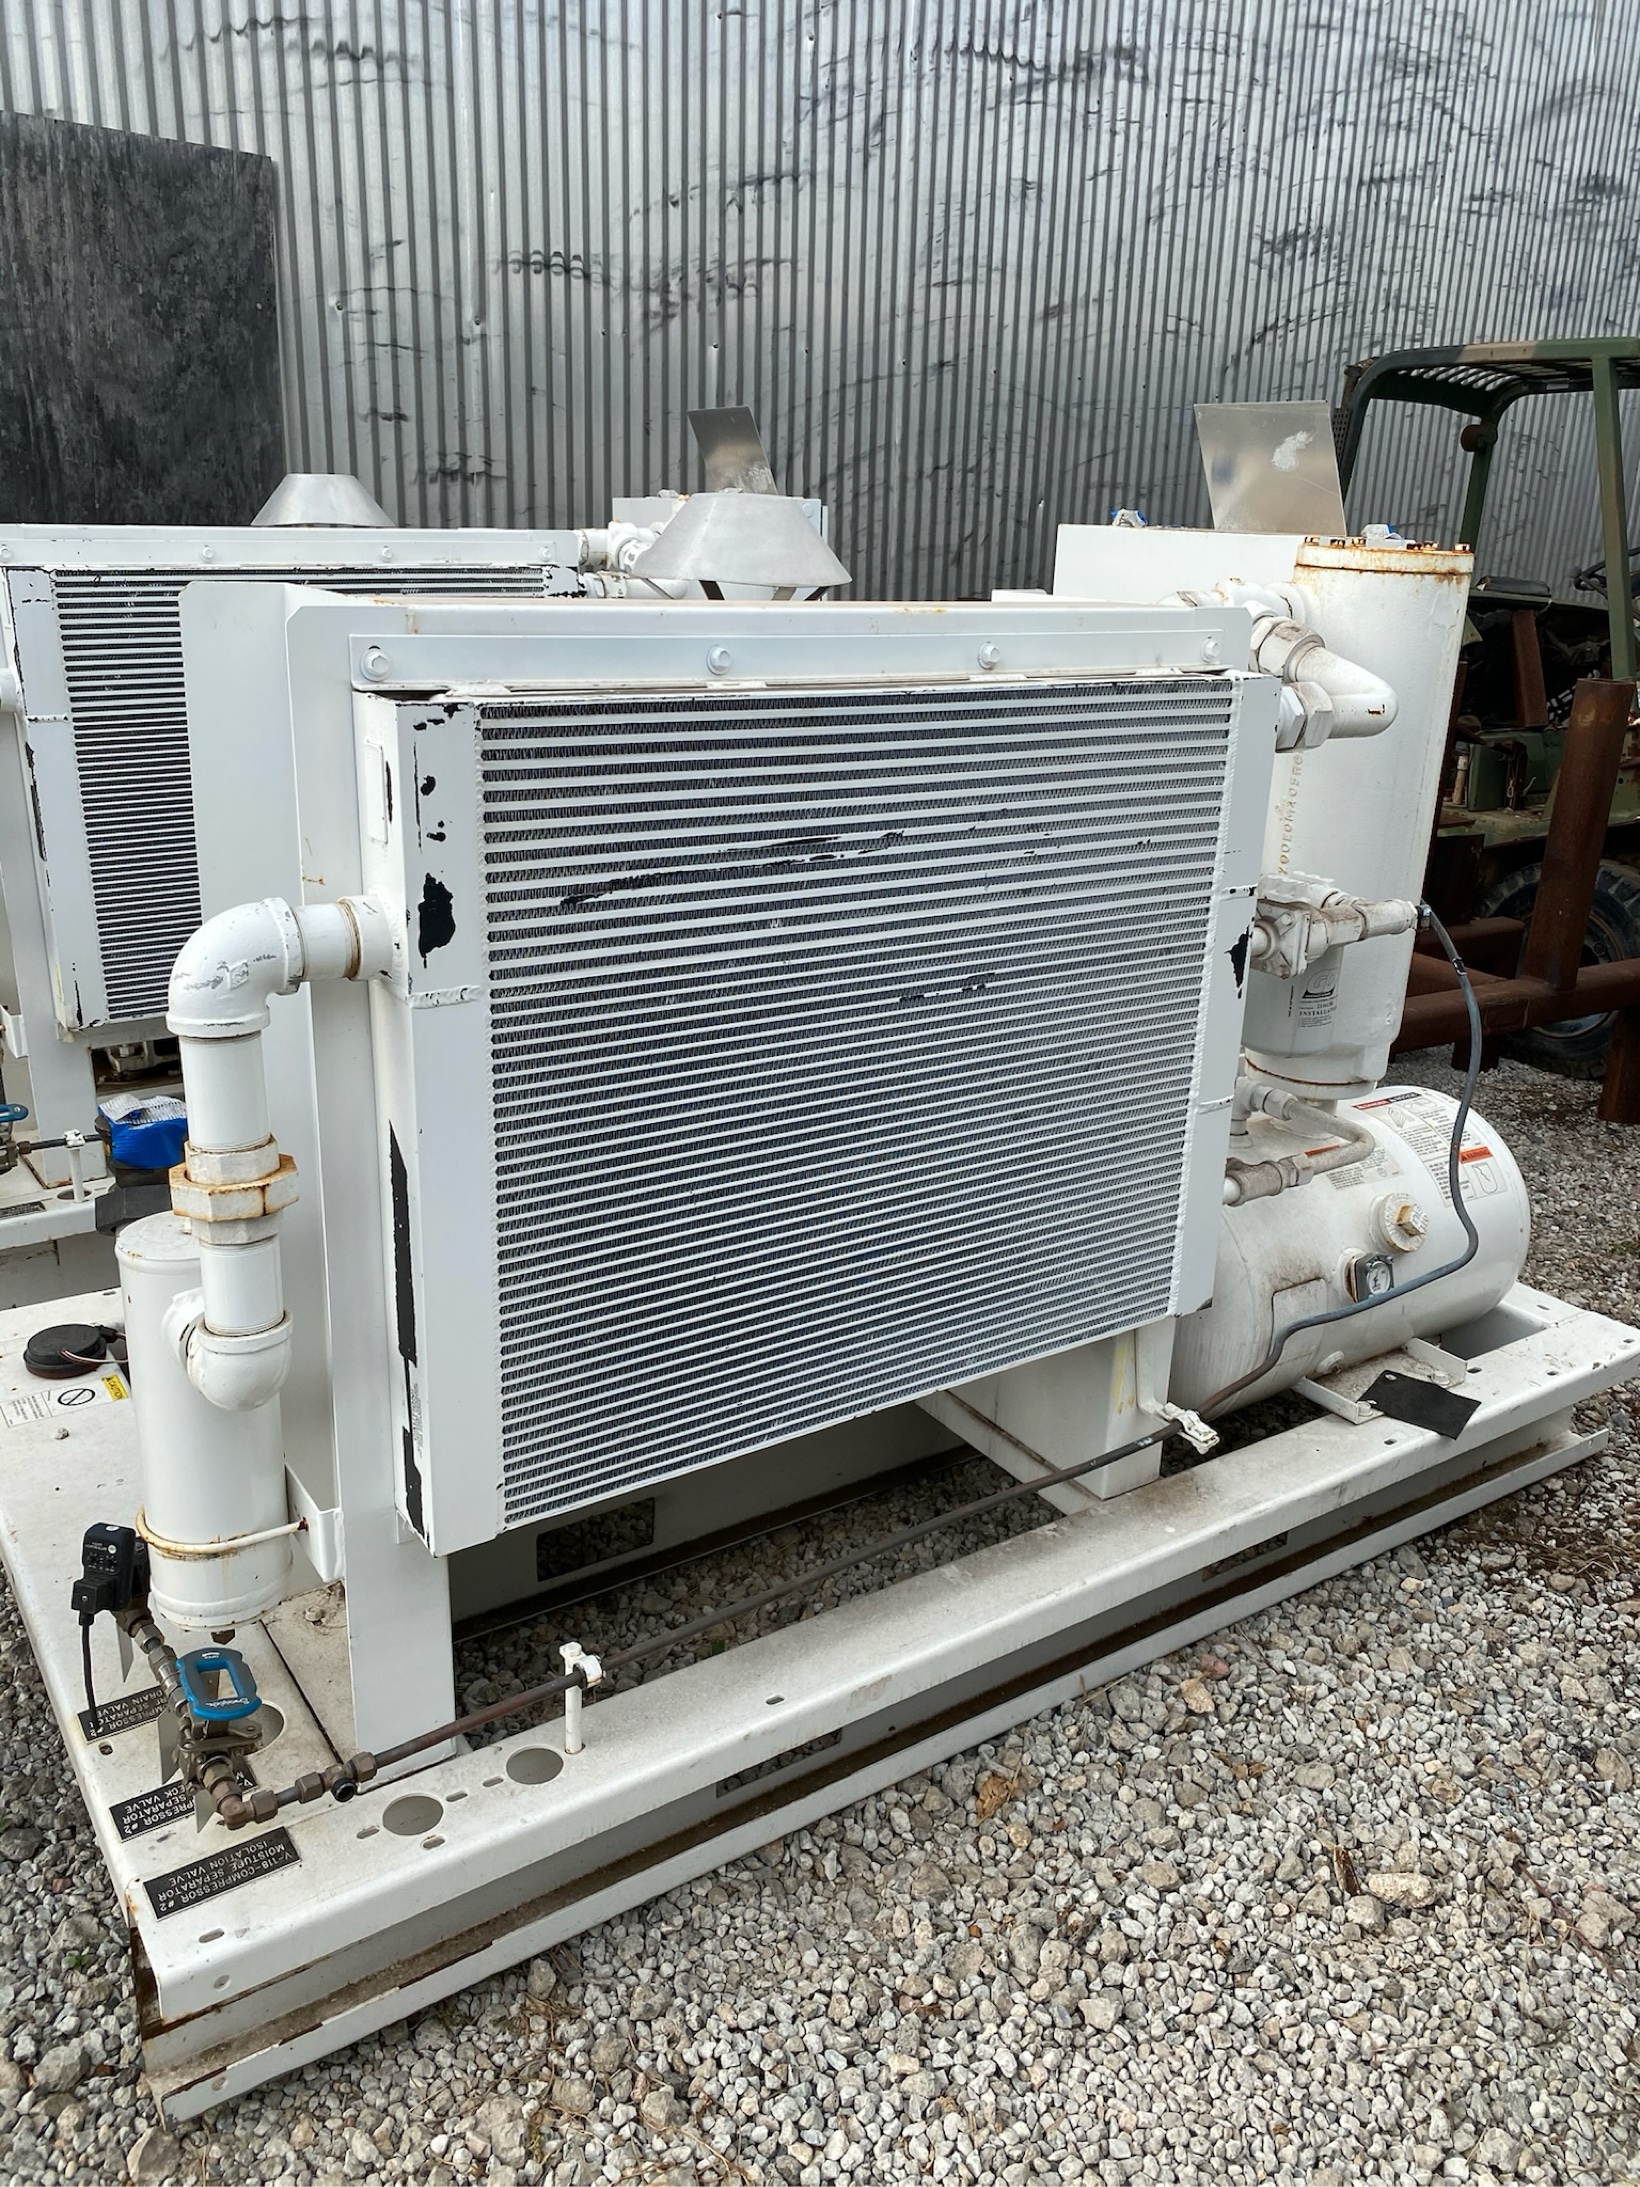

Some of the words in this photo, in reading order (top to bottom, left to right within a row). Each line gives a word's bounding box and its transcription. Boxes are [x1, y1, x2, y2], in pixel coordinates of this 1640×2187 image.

[131, 1689, 163, 1704] DRAIN
[89, 1702, 150, 1728] SEPARATO
[97, 1703, 129, 1718] VALVE
[164, 1784, 186, 1798] ECK
[122, 1794, 187, 1825] SEPARATOR
[125, 1795, 161, 1813] VALVE
[143, 1800, 194, 1826] PRESSOR
[209, 1840, 268, 1870] ISOLATION
[231, 1843, 285, 1872] MOISTURE
[158, 1867, 225, 1901] SEPARATOR
[169, 1866, 206, 1887] VALVE
[159, 1900, 175, 1912] #2
